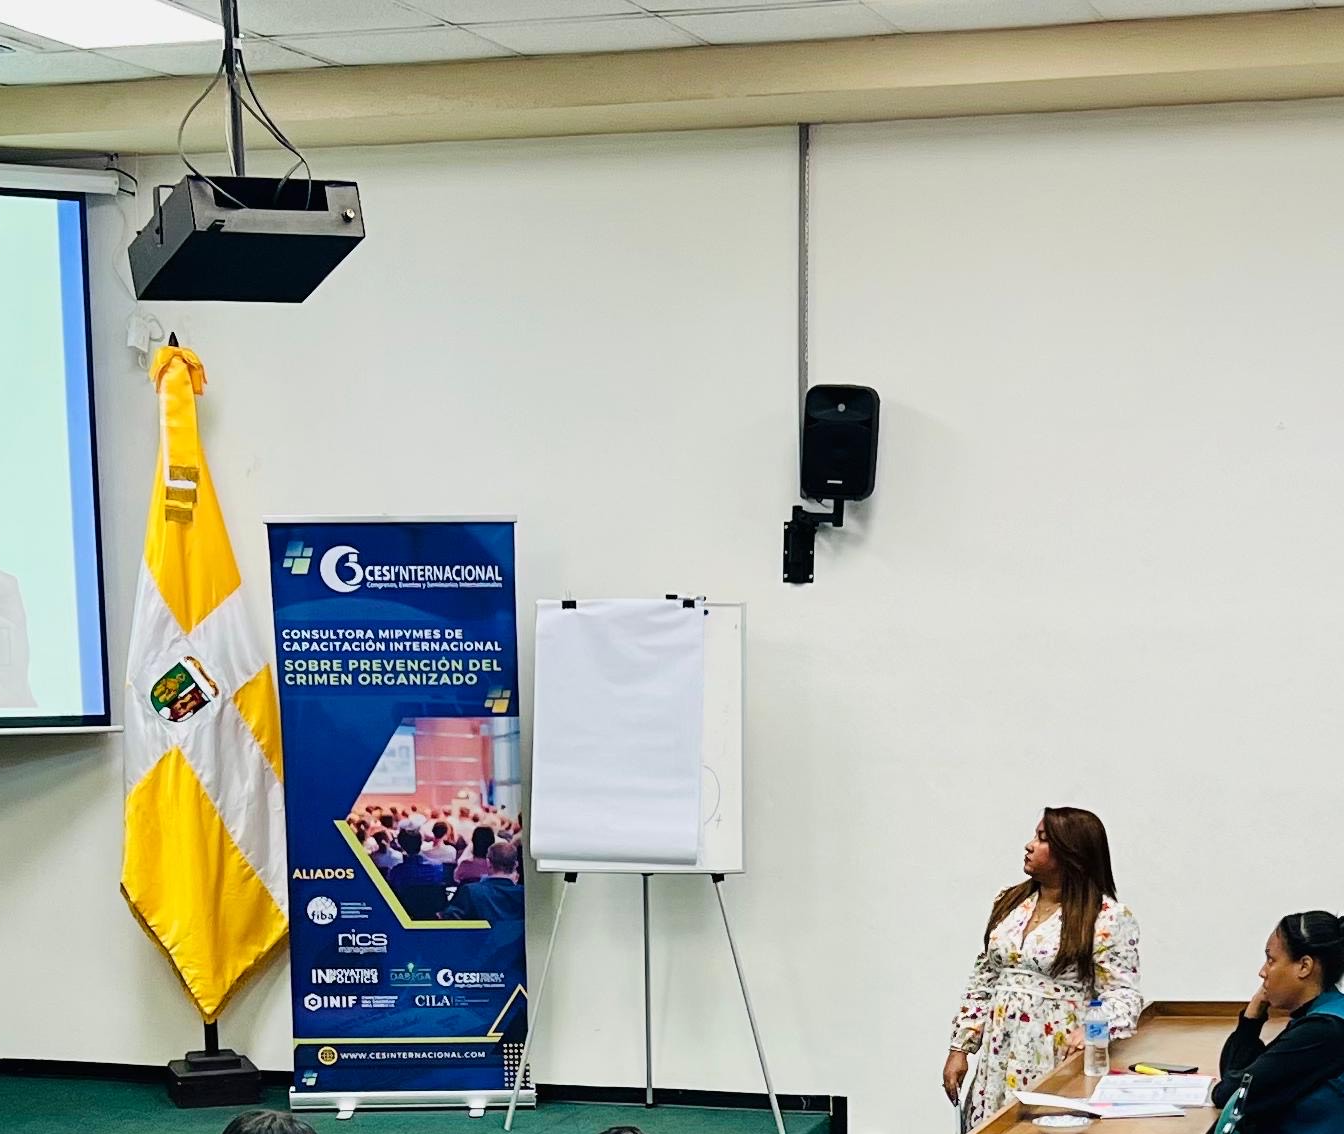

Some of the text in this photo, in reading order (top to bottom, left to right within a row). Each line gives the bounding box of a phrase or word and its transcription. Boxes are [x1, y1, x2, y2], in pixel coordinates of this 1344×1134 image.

[281, 629, 463, 640] CONSULTORA MIPYMES DE
[282, 639, 502, 651] CAPACITACIÓN INTERNACIONAL
[284, 656, 502, 672] SOBRE PREVENCIÓN DEL
[284, 673, 478, 686] CRIMEN ORGANIZADO
[292, 868, 355, 880] ALIADOS
[311, 910, 334, 920] fiba
[338, 928, 388, 946] rics
[323, 995, 358, 1008] INIF
[415, 995, 451, 1007] CILA
